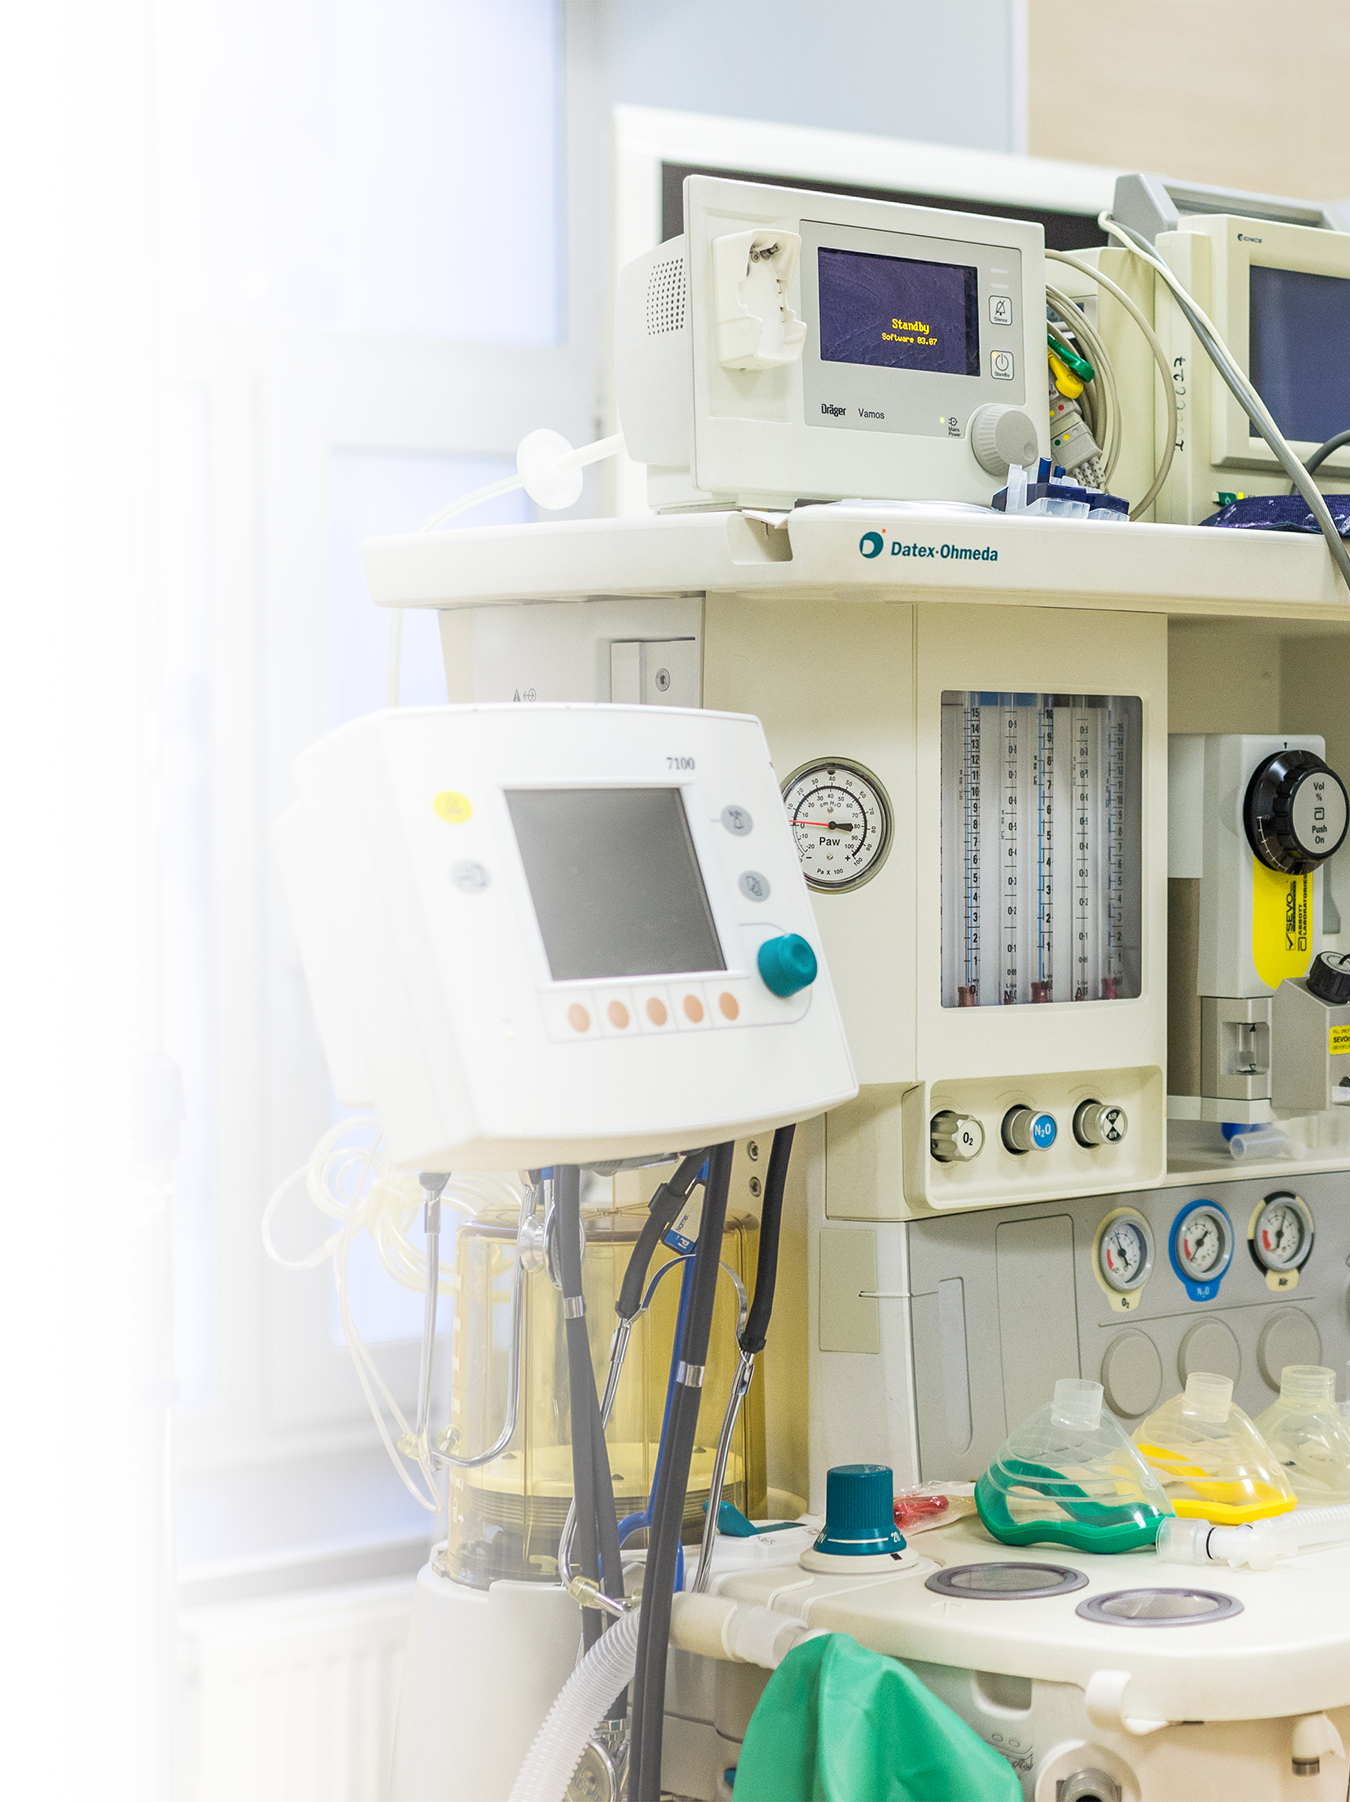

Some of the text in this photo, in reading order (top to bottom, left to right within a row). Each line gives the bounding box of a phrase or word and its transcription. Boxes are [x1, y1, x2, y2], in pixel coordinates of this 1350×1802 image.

[892, 318, 929, 335] Standby
[881, 332, 914, 343] Software
[821, 403, 846, 417] Dräger
[858, 407, 885, 419] Vamos
[971, 707, 979, 718] 15
[971, 723, 979, 733] 14
[971, 739, 979, 749] 13
[666, 757, 695, 770] 7100
[971, 755, 979, 765] 12
[971, 770, 979, 780] 11
[971, 786, 979, 797] 10
[1313, 782, 1325, 791] Vol
[973, 802, 978, 812] 9
[973, 819, 978, 829] 8
[1311, 824, 1327, 833] Push
[819, 836, 840, 846] Paw
[973, 837, 978, 847] 7
[1314, 835, 1324, 844] On
[973, 854, 978, 865] 6
[973, 873, 978, 883] 5
[973, 892, 978, 902] 4
[973, 912, 978, 922] 3
[973, 933, 978, 943] 2
[1034, 1123, 1051, 1138] N2O
[962, 1131, 974, 1146] O2
